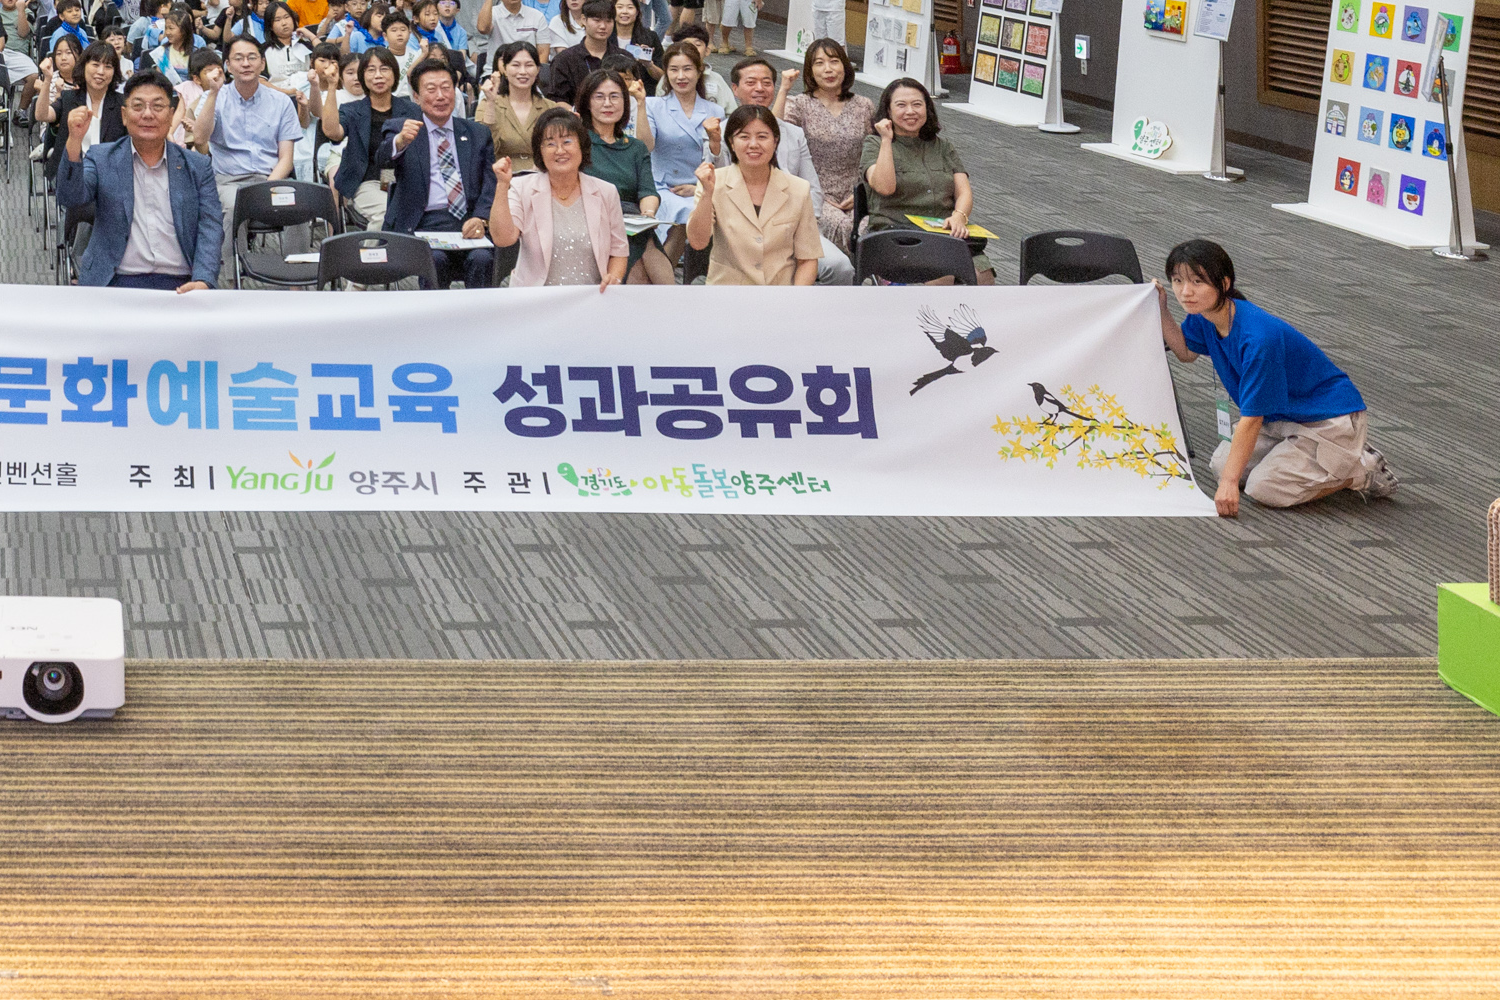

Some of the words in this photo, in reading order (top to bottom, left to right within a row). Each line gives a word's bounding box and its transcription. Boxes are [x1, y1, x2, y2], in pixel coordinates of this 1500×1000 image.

[492, 364, 878, 440] 성과공유회
[129, 465, 152, 488] 주
[349, 470, 438, 496] 양주시
[463, 471, 486, 494] 주
[581, 472, 627, 492] 경기도
